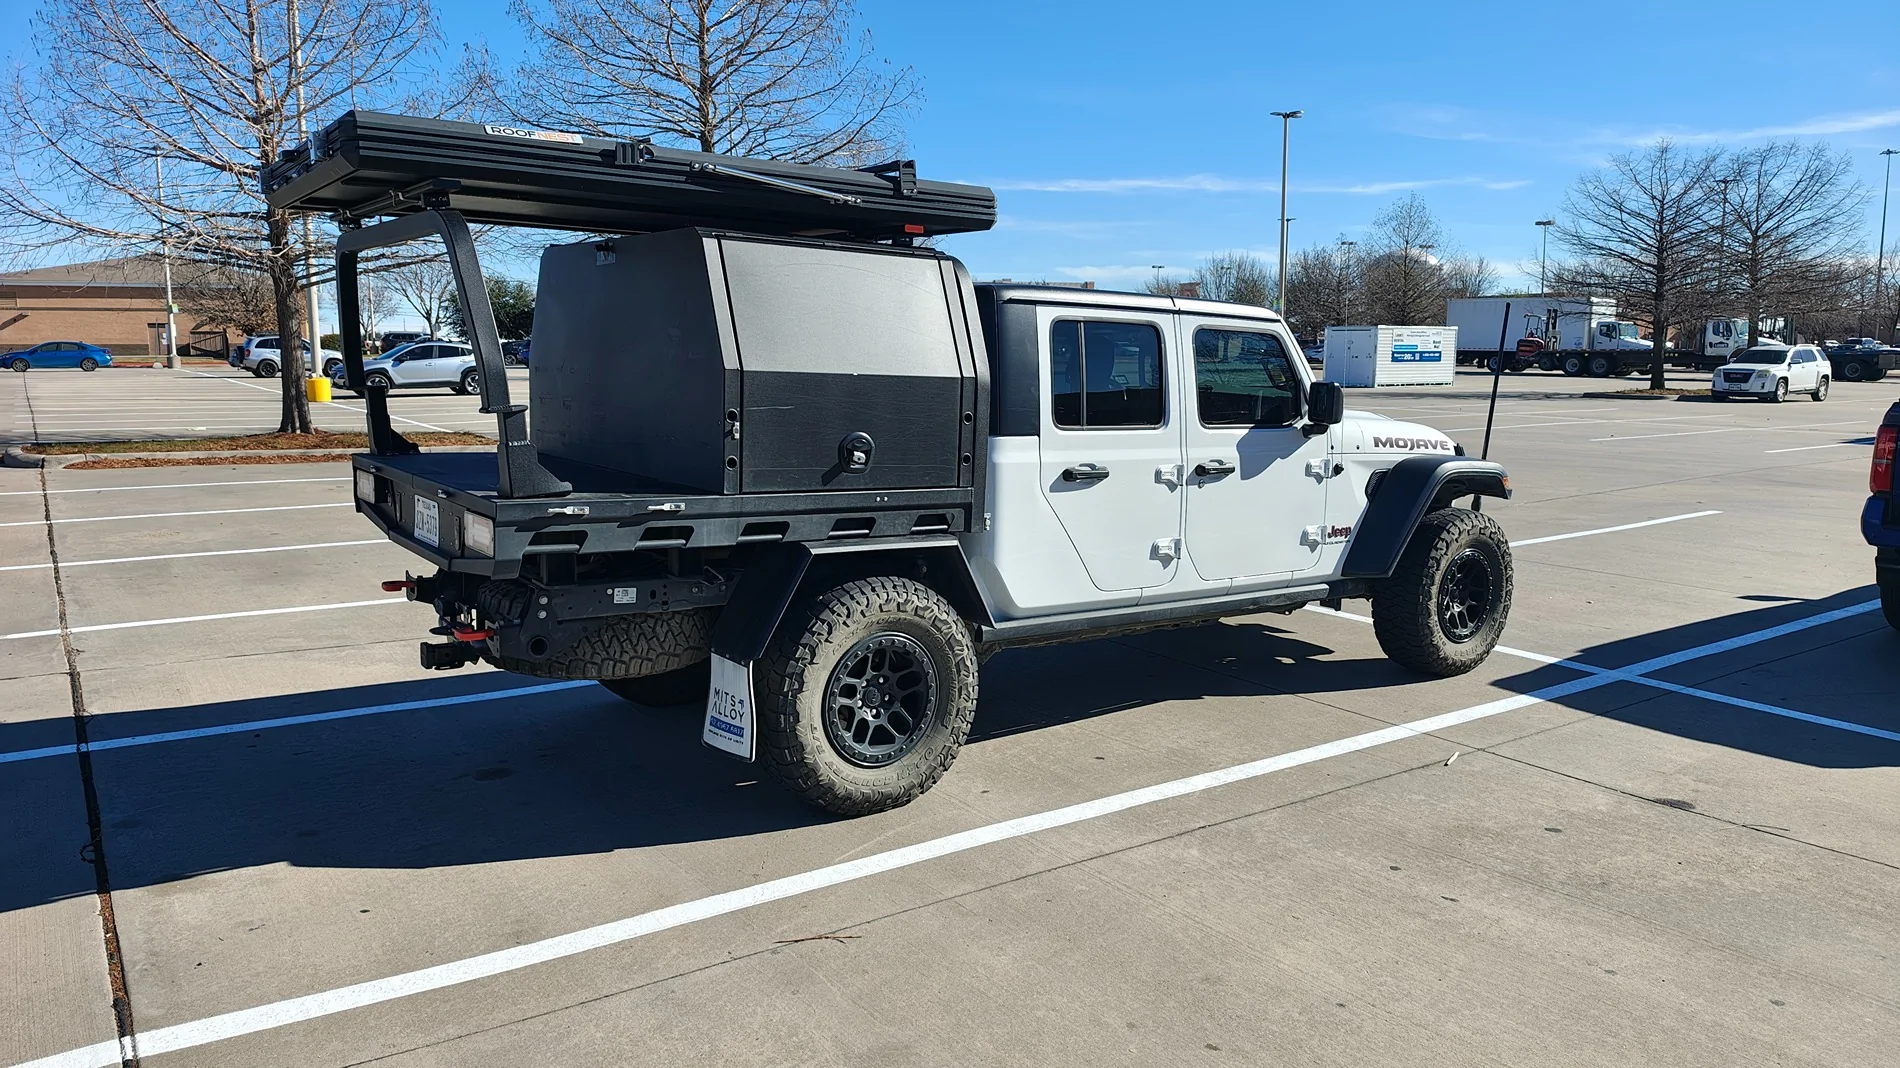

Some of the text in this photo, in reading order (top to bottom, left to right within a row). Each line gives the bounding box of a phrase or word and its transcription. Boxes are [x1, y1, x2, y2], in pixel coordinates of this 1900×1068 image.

[490, 126, 576, 141] ROOFNEST
[1372, 436, 1451, 451] MOJAVE
[1328, 525, 1351, 538] Jeep
[714, 687, 736, 707] MITS
[711, 700, 745, 723] ALLOY
